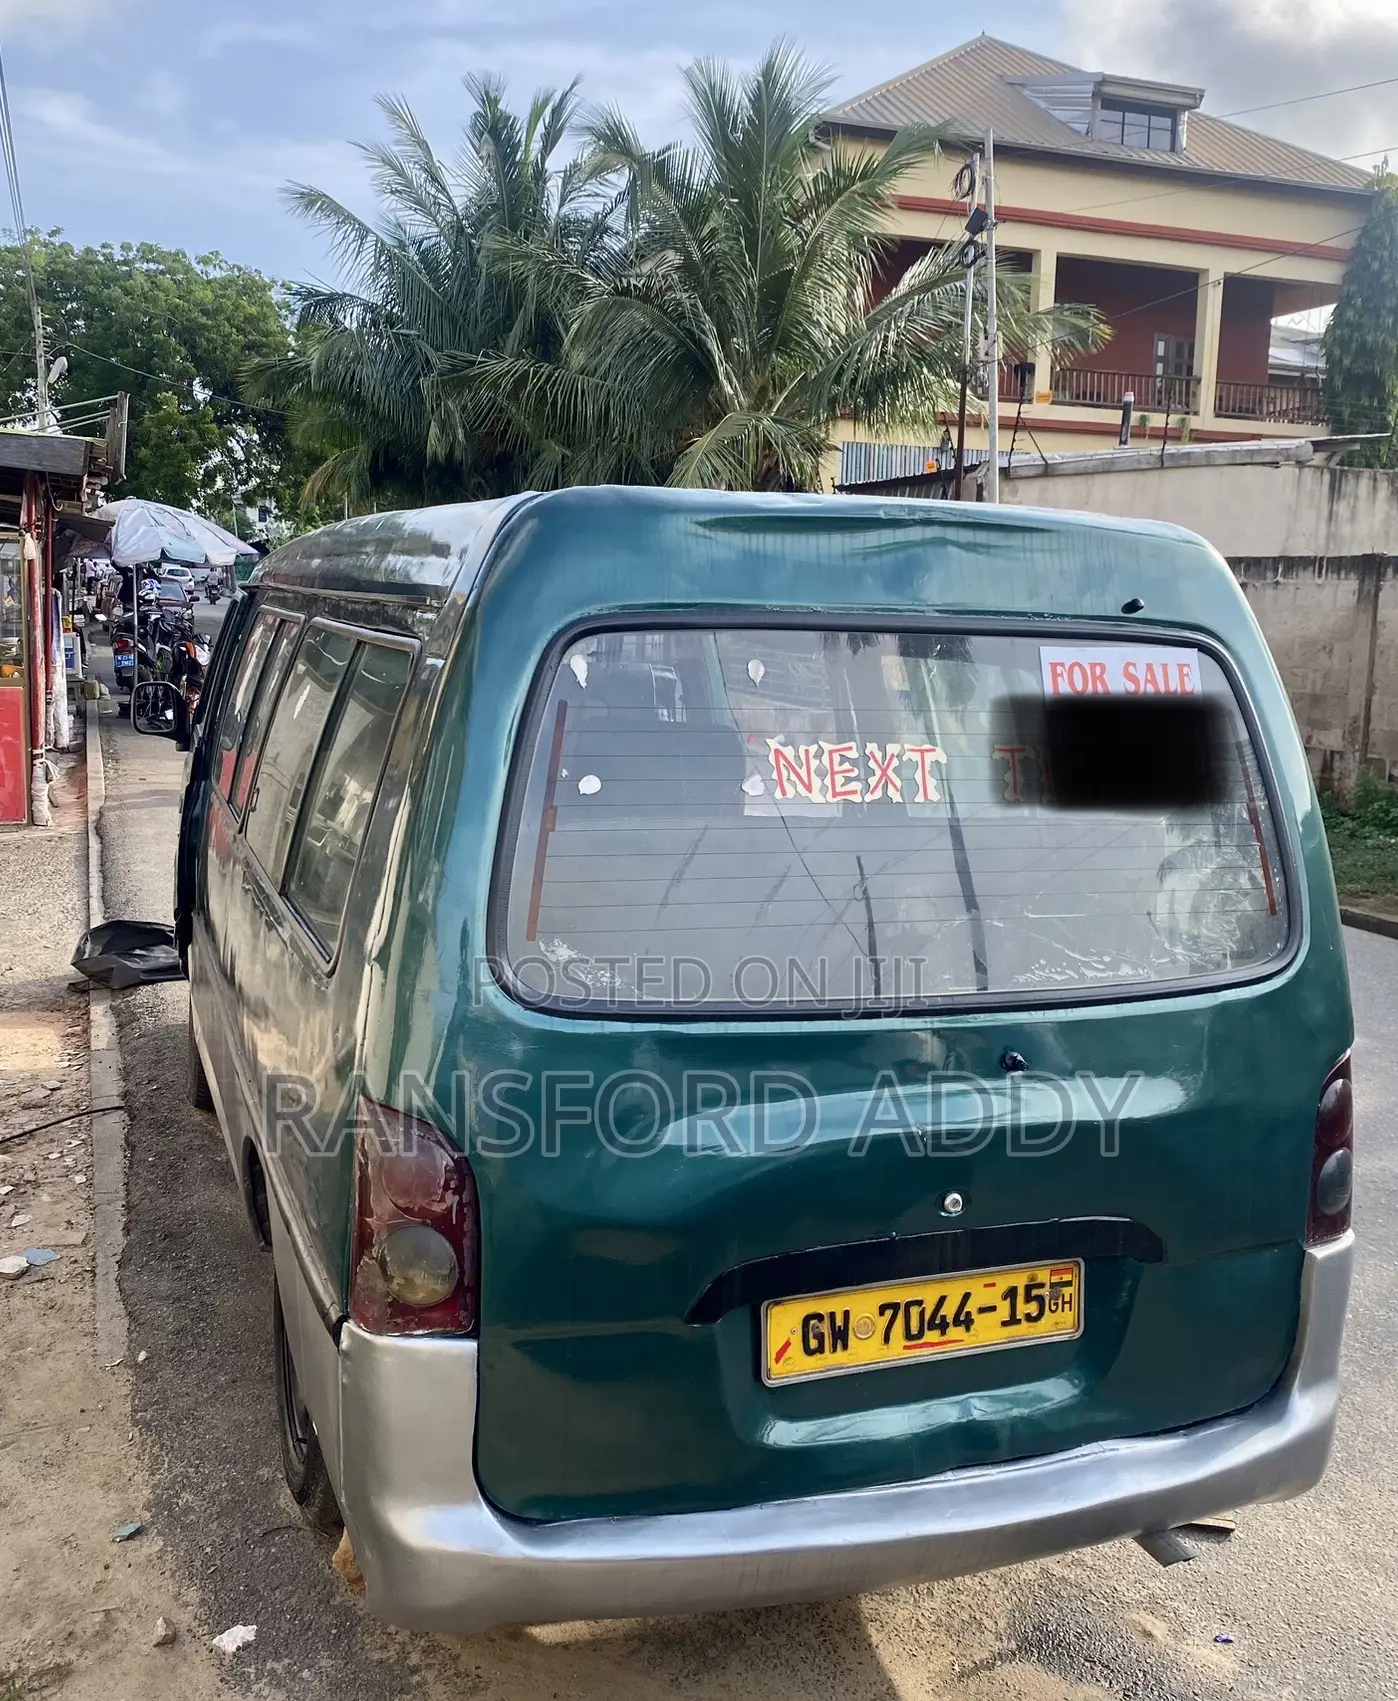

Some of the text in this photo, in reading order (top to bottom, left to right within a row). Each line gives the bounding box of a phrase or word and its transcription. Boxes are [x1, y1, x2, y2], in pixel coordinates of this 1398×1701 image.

[1048, 661, 1196, 697] FOR SALE
[770, 742, 942, 801] NEXT
[801, 1282, 1046, 1357] GW 7044-15
[1048, 1292, 1073, 1314] GH
